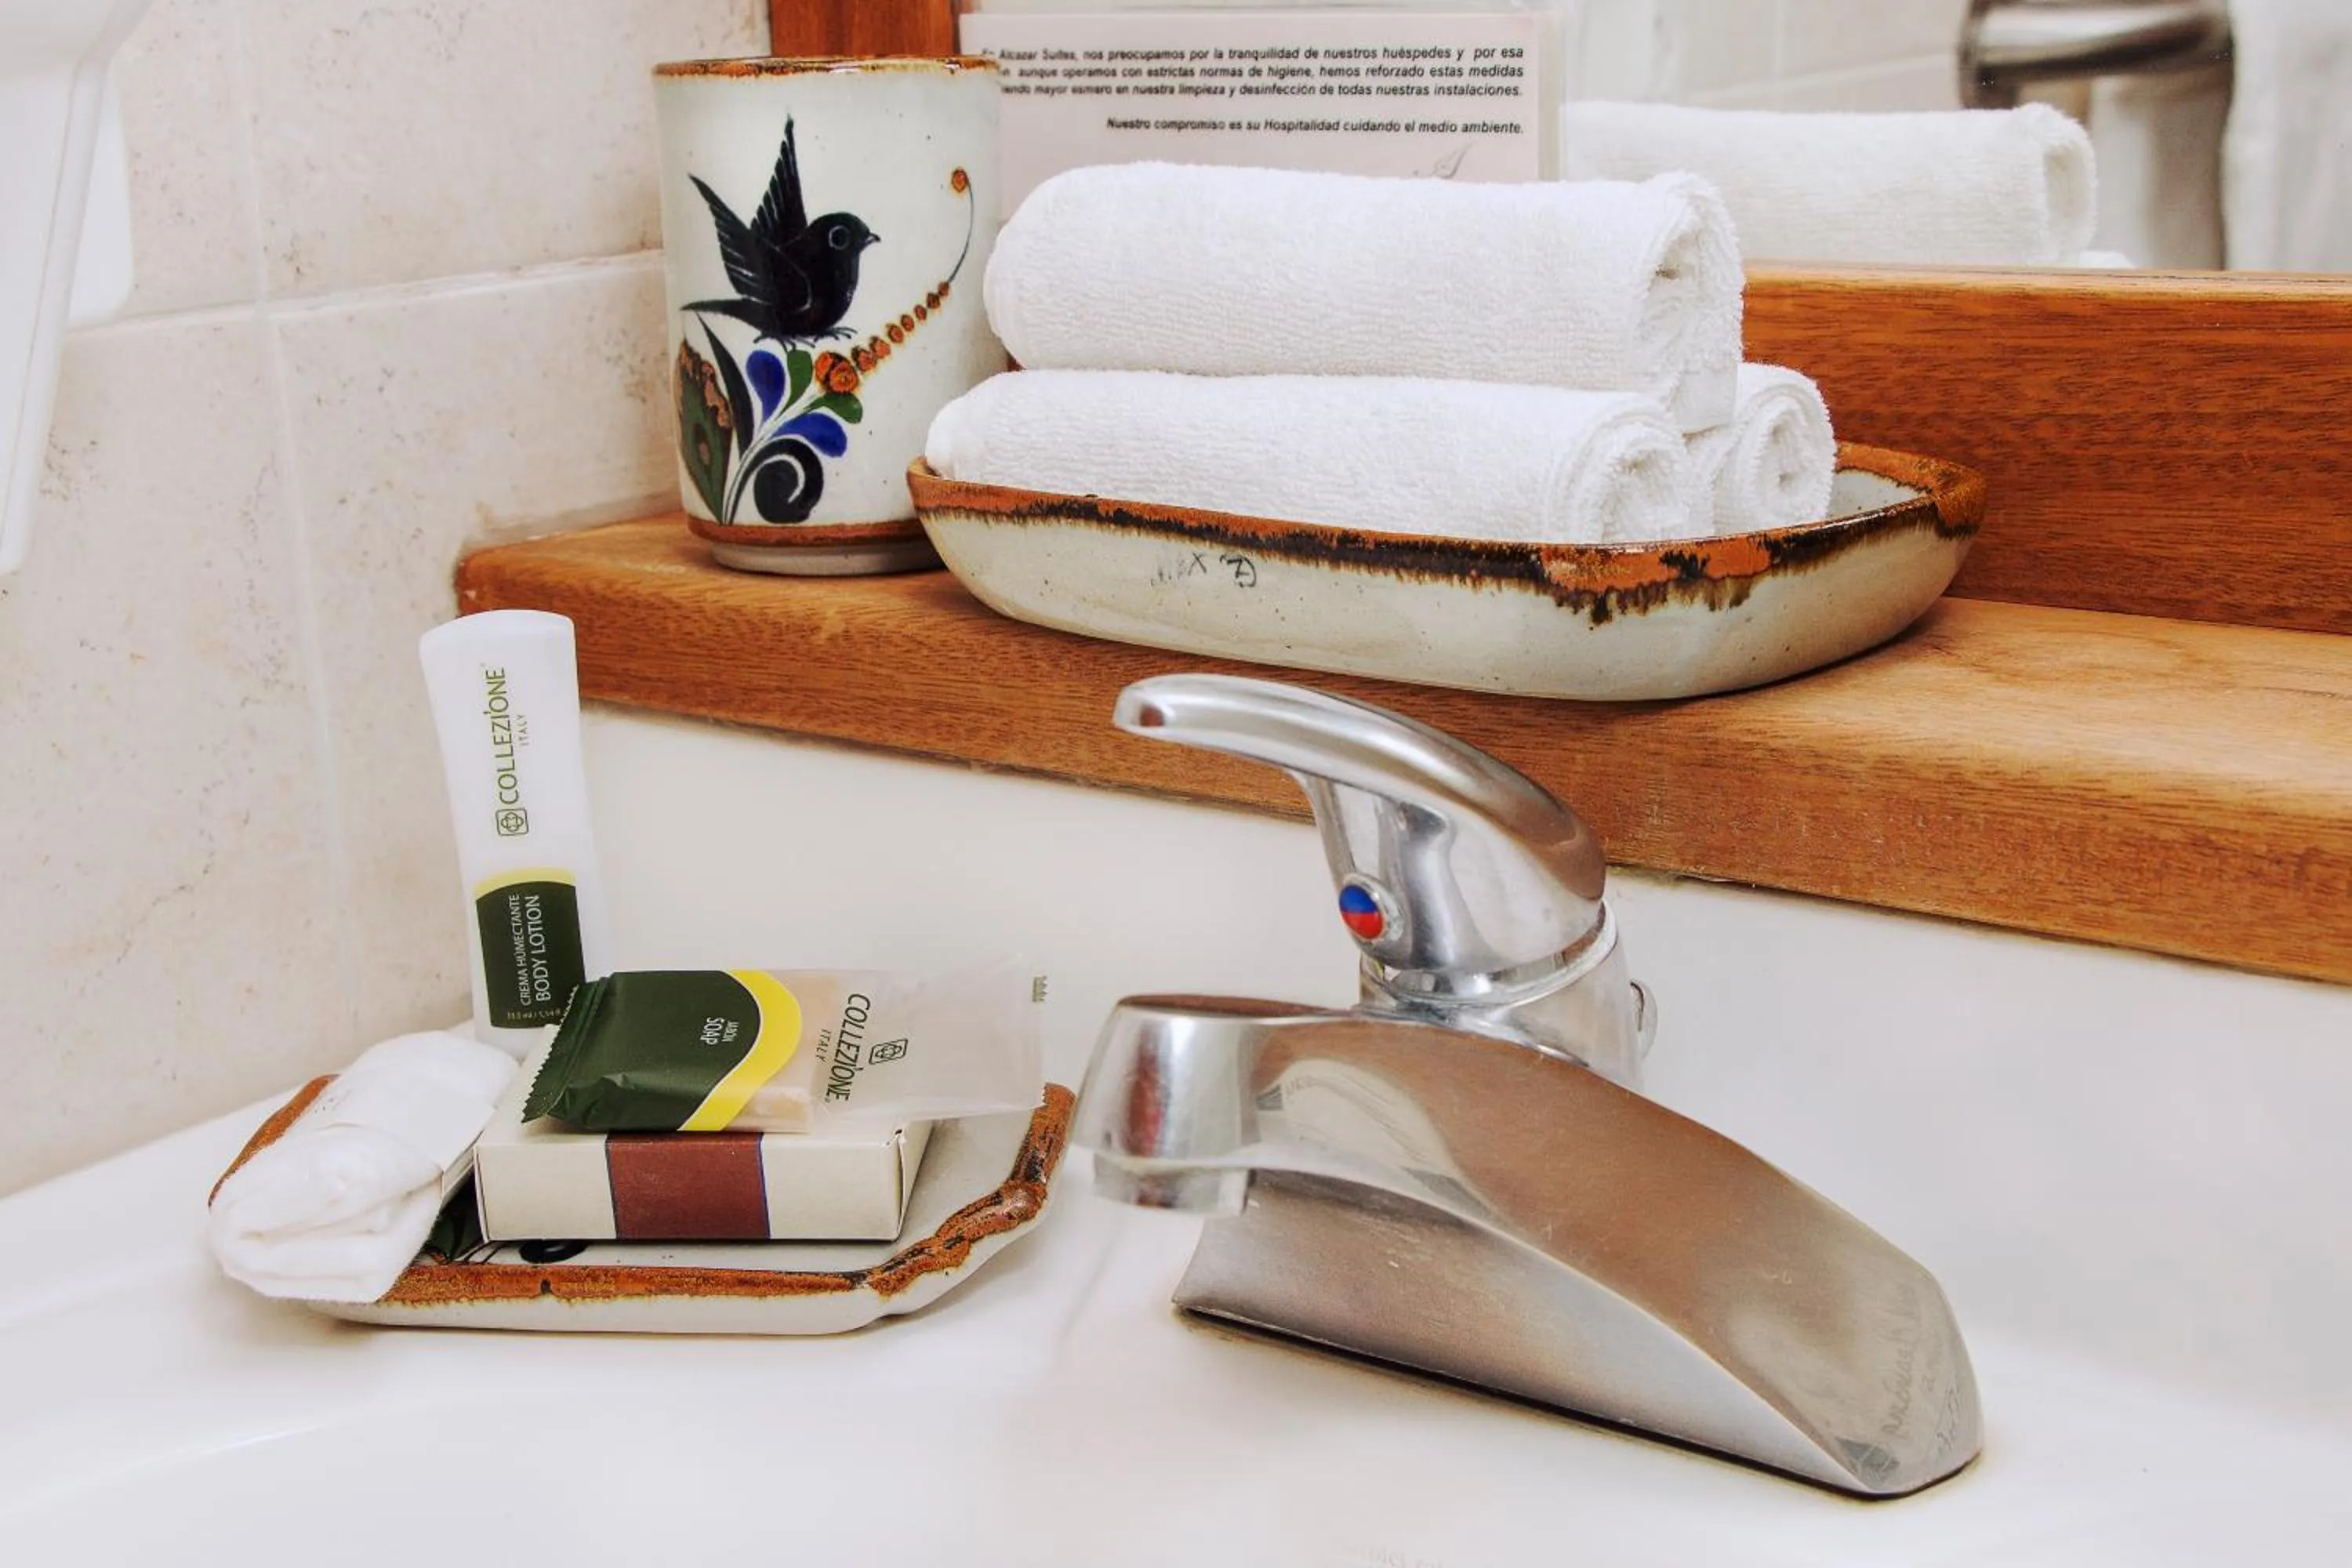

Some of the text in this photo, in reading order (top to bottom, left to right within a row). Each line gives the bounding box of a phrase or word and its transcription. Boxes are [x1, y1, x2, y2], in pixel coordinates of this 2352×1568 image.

[1000, 49, 1036, 60] Alcazar
[1042, 48, 1078, 62] Suites,
[1083, 51, 1103, 60] nos
[1107, 49, 1185, 62] preocupamos
[1189, 49, 1210, 61] por
[1214, 47, 1224, 60] la
[1229, 48, 1300, 61] tranquilidad
[1304, 48, 1319, 59] de
[1323, 48, 1377, 59] nuestros
[1382, 45, 1450, 61] huéspedes
[1456, 49, 1465, 61] y
[1473, 47, 1497, 61] por
[1501, 47, 1523, 58] esa
[1018, 67, 1058, 79] aunque
[1062, 67, 1117, 79] operamos
[1121, 67, 1142, 77] con
[1147, 66, 1196, 77] estrictas
[1200, 67, 1243, 77] normas
[1247, 65, 1263, 77] de
[1267, 65, 1316, 80] higiene,
[1319, 65, 1360, 77] hemos
[1365, 64, 1425, 77] reforzado
[1429, 65, 1464, 77] estas
[1468, 64, 1524, 77] medidas
[1035, 85, 1068, 97] mayor
[1071, 85, 1112, 95] esmero
[1116, 85, 1129, 94] en
[1132, 84, 1175, 95] nuestra
[1178, 83, 1225, 96] limpieza
[1229, 86, 1236, 97] y
[1319, 83, 1334, 95] de
[1338, 83, 1372, 95] todas
[1376, 84, 1429, 95] nuestras
[1434, 83, 1523, 96] instalaciones.
[1107, 118, 1524, 134] Nuestro compromiso es su Hospitalidad cuidando el medio ambiente.
[516, 714, 530, 746] ITALY
[508, 892, 532, 1006] CREMA HUMECTANTE
[524, 895, 552, 1002] BODY LOTION
[700, 1017, 725, 1045] SOAP
[815, 1029, 832, 1062] ITALY
